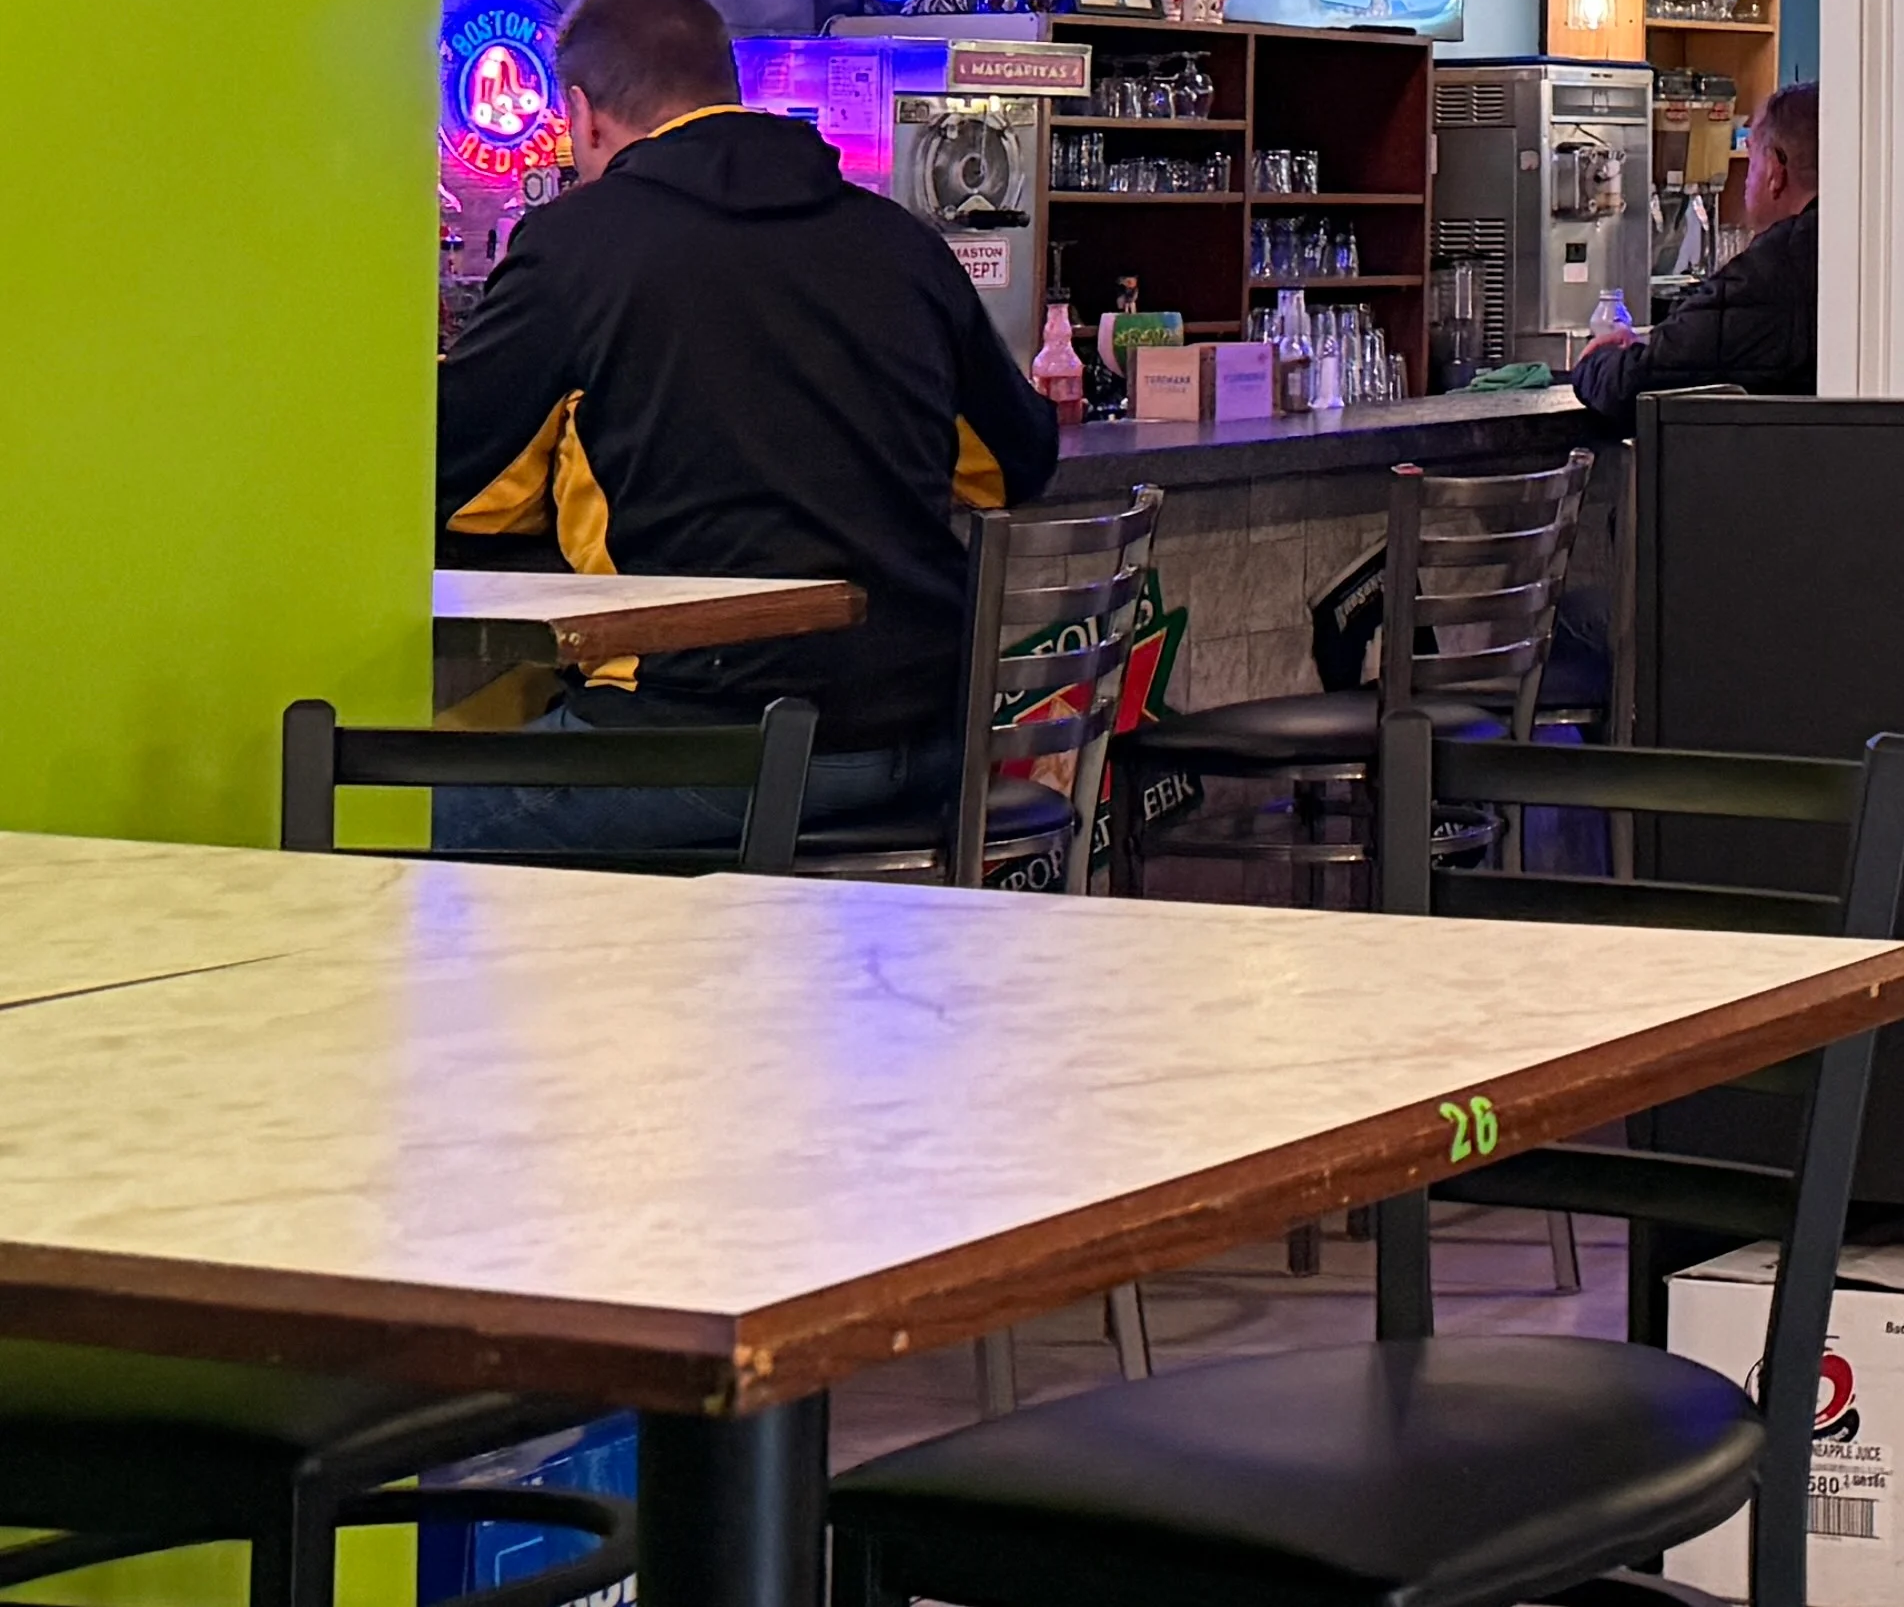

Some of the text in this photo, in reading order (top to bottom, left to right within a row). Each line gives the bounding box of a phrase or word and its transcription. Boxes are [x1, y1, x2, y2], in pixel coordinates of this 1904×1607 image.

[452, 10, 536, 57] BOSTON
[972, 62, 1067, 79] MARGARITAS
[458, 132, 511, 173] RED
[1144, 770, 1194, 821] EER
[1438, 1096, 1499, 1163] 26
